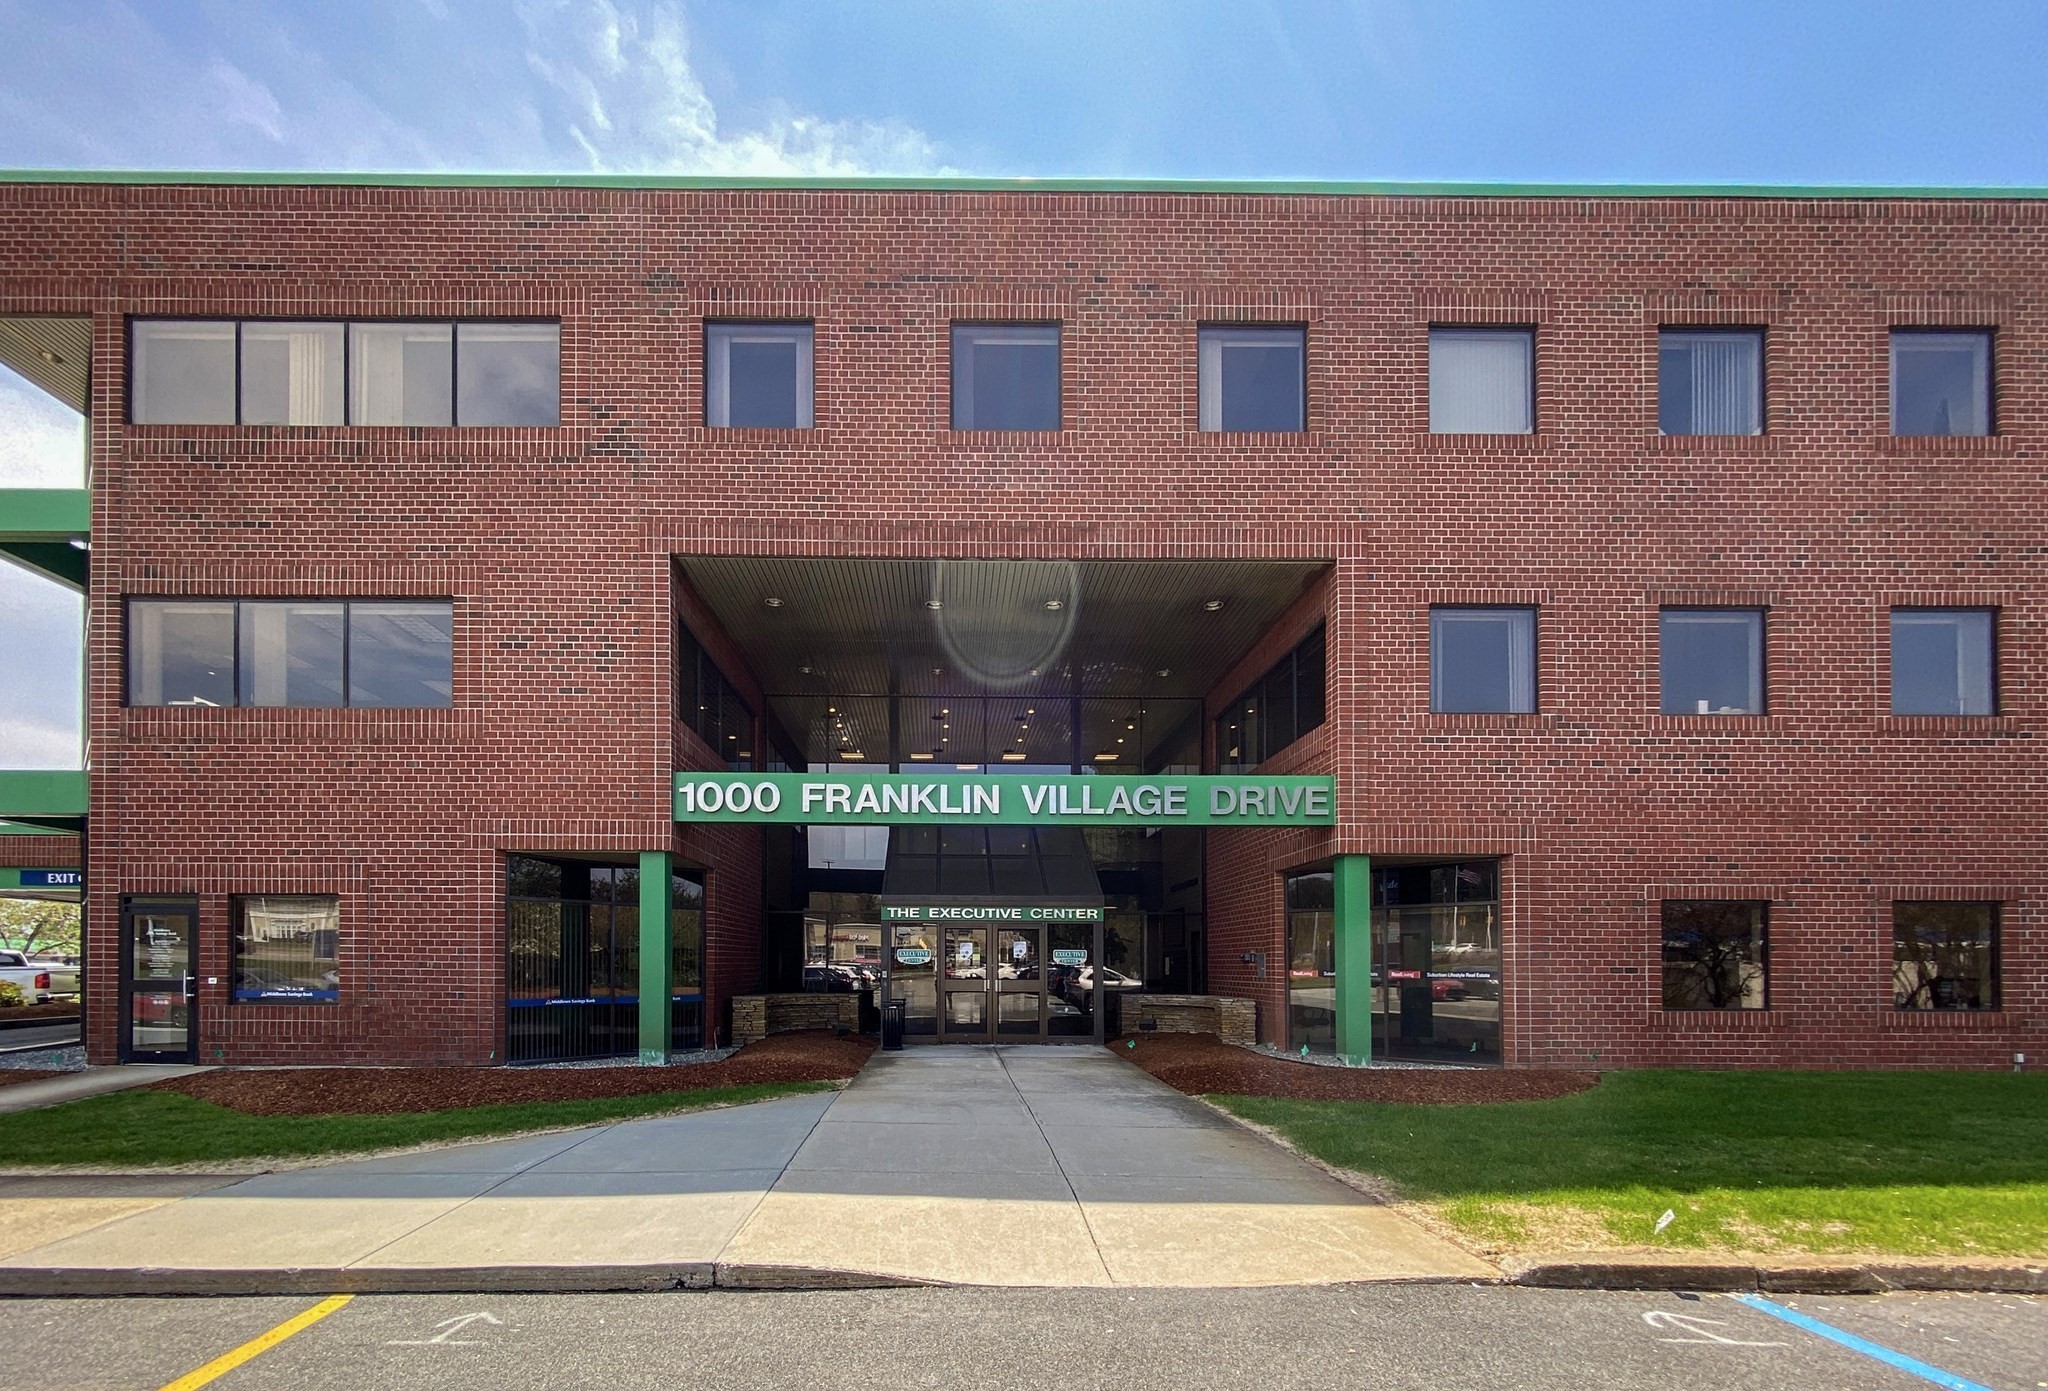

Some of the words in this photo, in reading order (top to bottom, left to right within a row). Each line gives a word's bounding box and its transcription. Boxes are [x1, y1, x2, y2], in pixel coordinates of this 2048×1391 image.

[678, 782, 781, 813] 1000
[802, 783, 1000, 814] FRANKLIN
[1021, 785, 1188, 816] VILLAGE
[1210, 785, 1330, 816] DRIVE
[47, 873, 76, 884] EXIT
[887, 907, 920, 918] THE
[928, 907, 1022, 919] EXECUTIVE
[1029, 908, 1098, 919] CENTER
